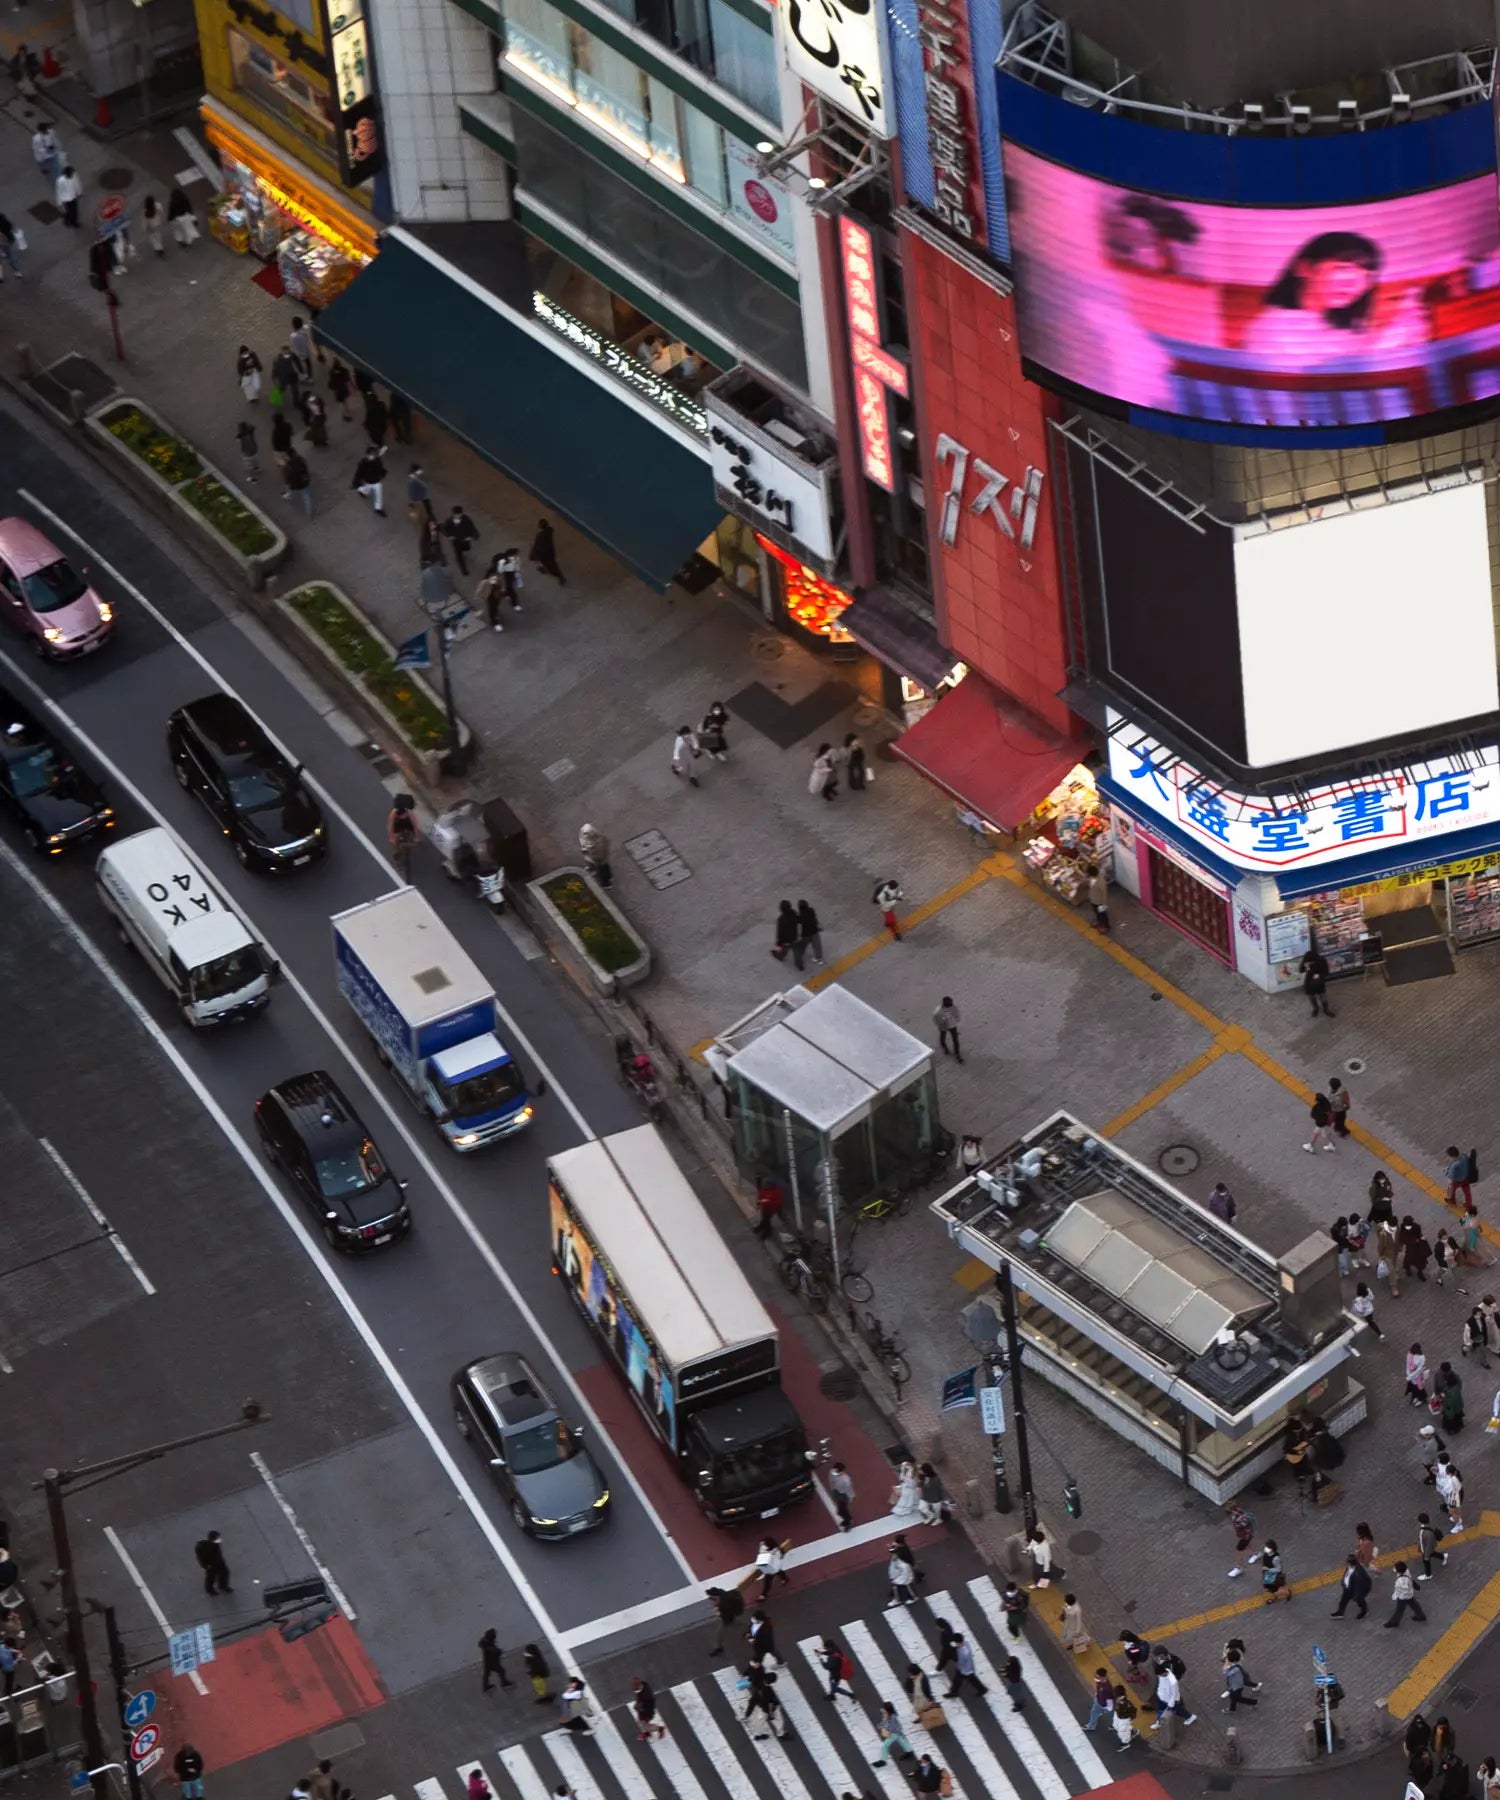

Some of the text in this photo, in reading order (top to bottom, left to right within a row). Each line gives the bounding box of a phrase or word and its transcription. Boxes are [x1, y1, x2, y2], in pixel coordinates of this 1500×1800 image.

[789, 0, 882, 121] じゃ
[935, 432, 1044, 550] クスリ
[1129, 745, 1473, 852] 大盛堂書店
